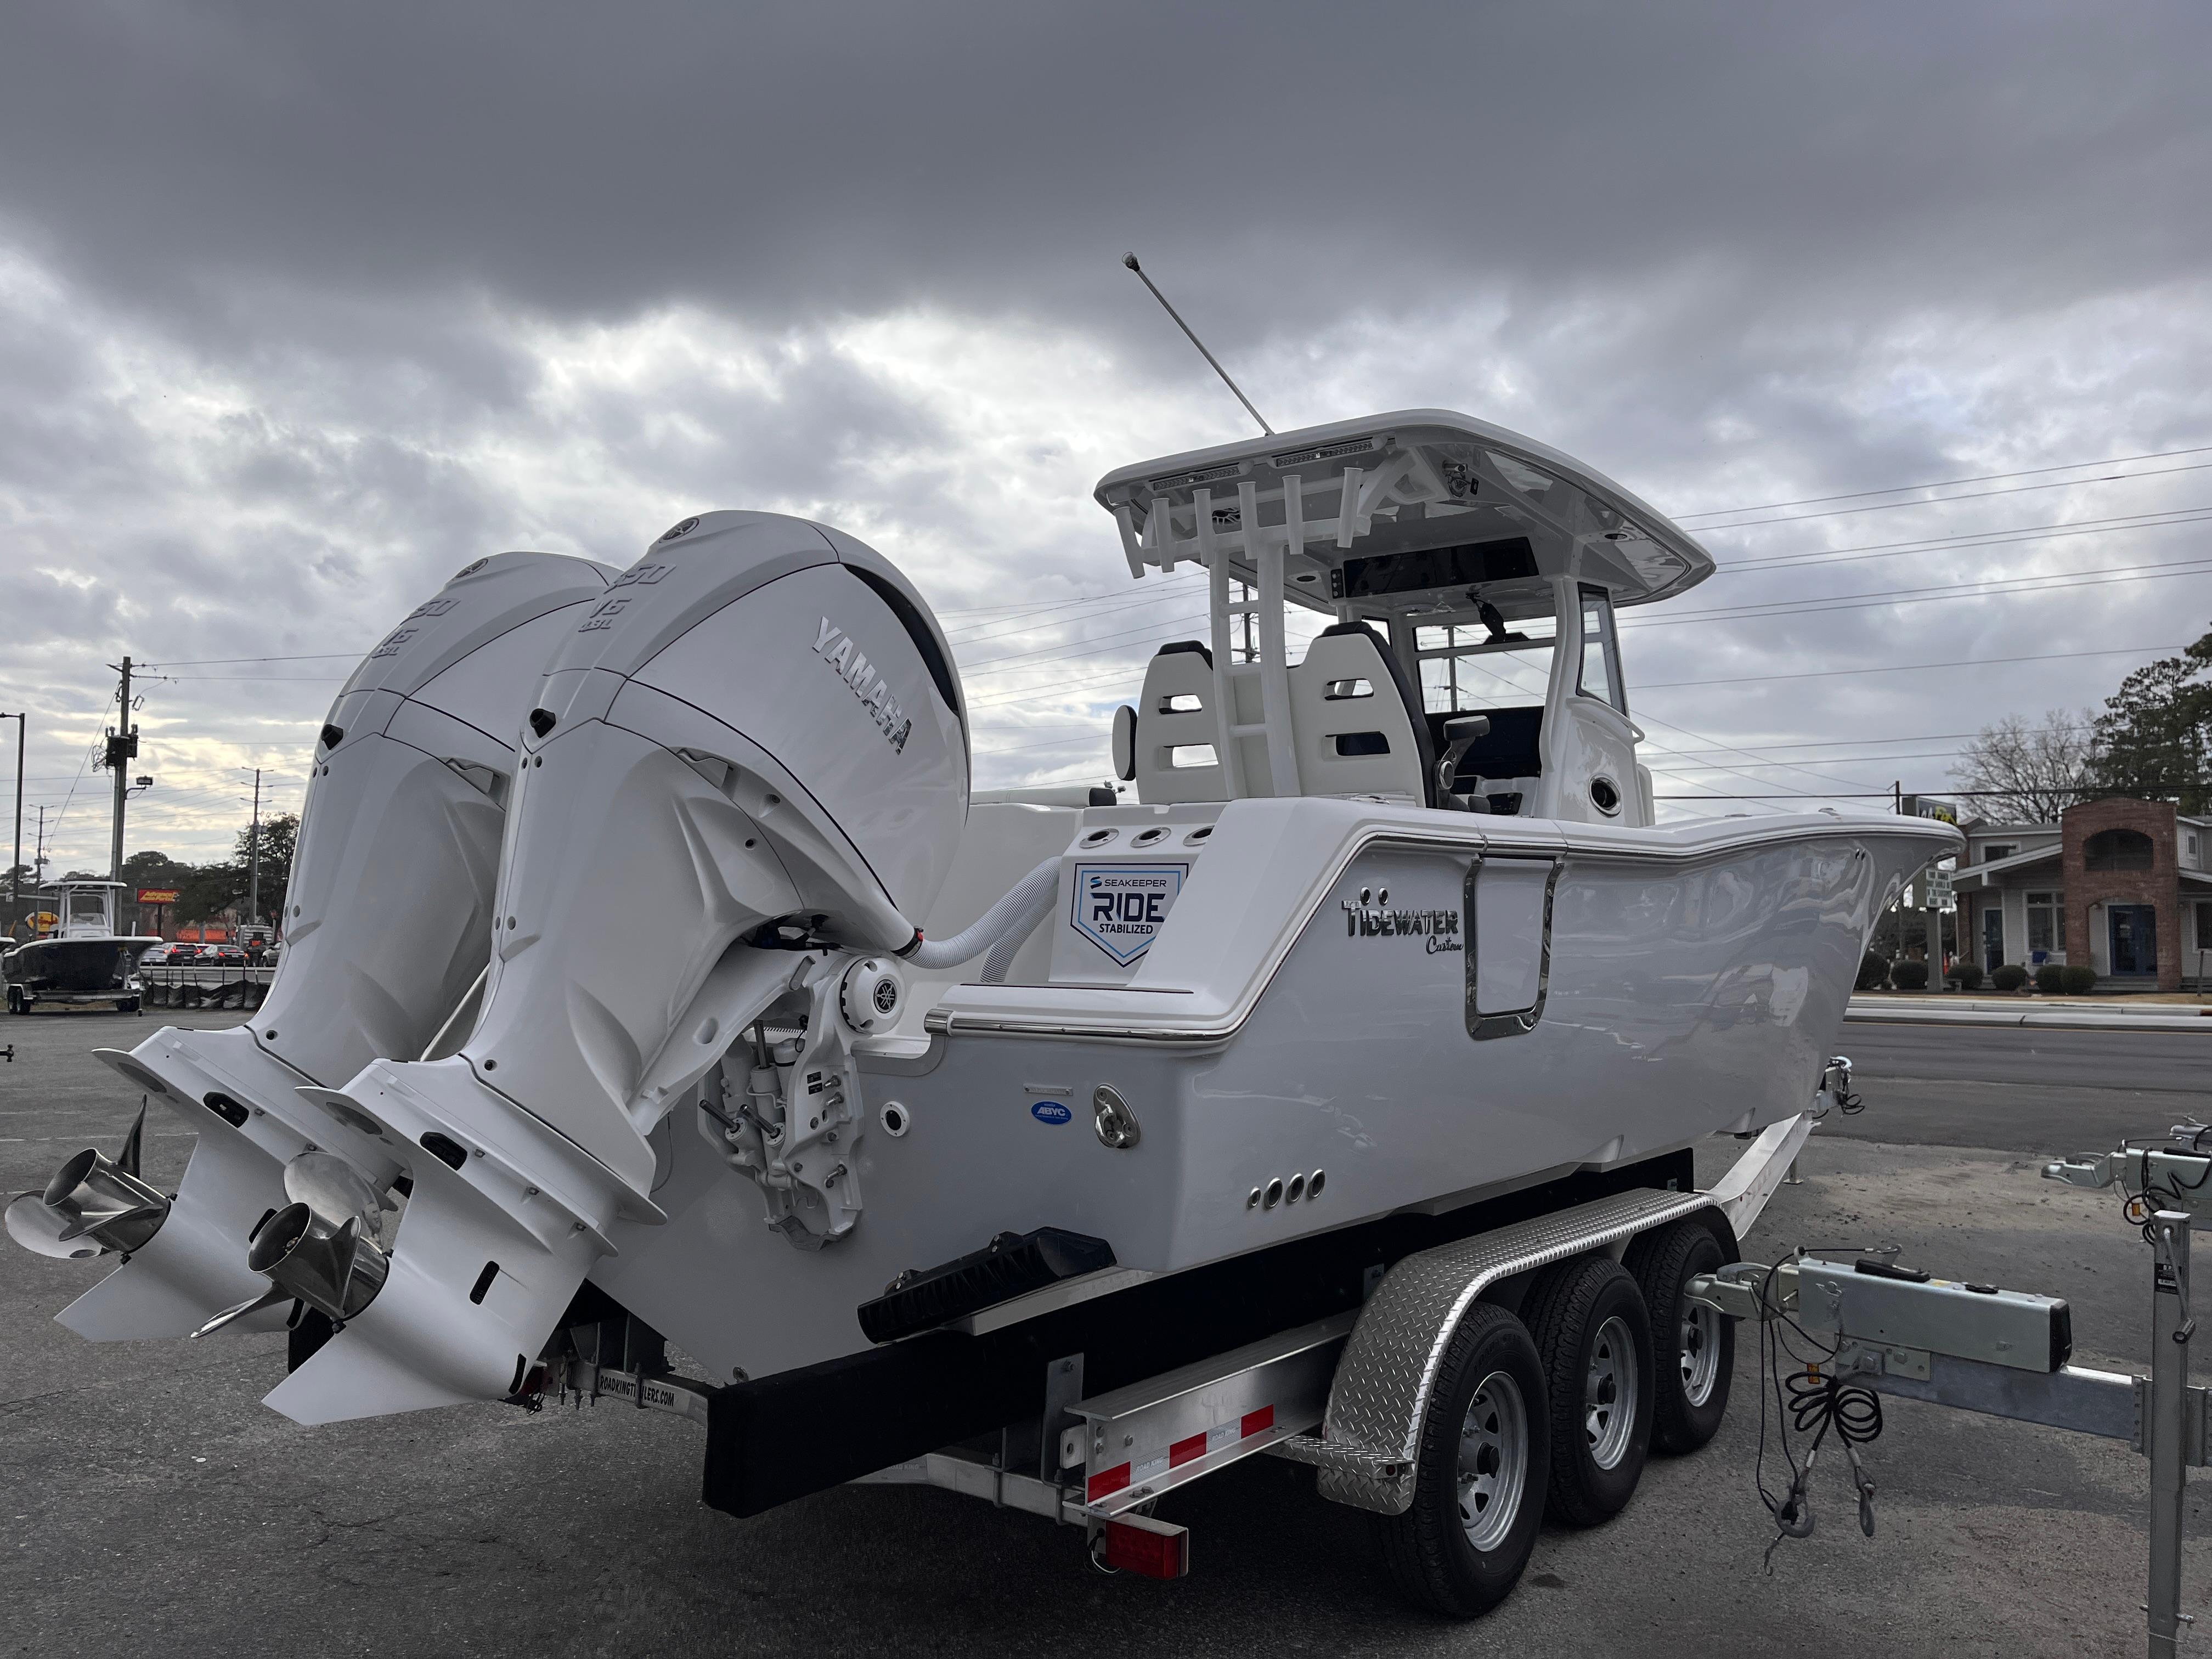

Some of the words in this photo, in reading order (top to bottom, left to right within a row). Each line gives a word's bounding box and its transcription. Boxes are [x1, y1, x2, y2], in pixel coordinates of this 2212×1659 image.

[812, 616, 912, 755] YAMAHA
[1104, 879, 1167, 888] SEAKEEPER
[1090, 893, 1166, 923] RIDE
[1341, 900, 1459, 936] TIDEWATER
[1099, 923, 1154, 935] STABILIZED
[1426, 935, 1464, 955] Custom
[1037, 1107, 1066, 1116] ABYC
